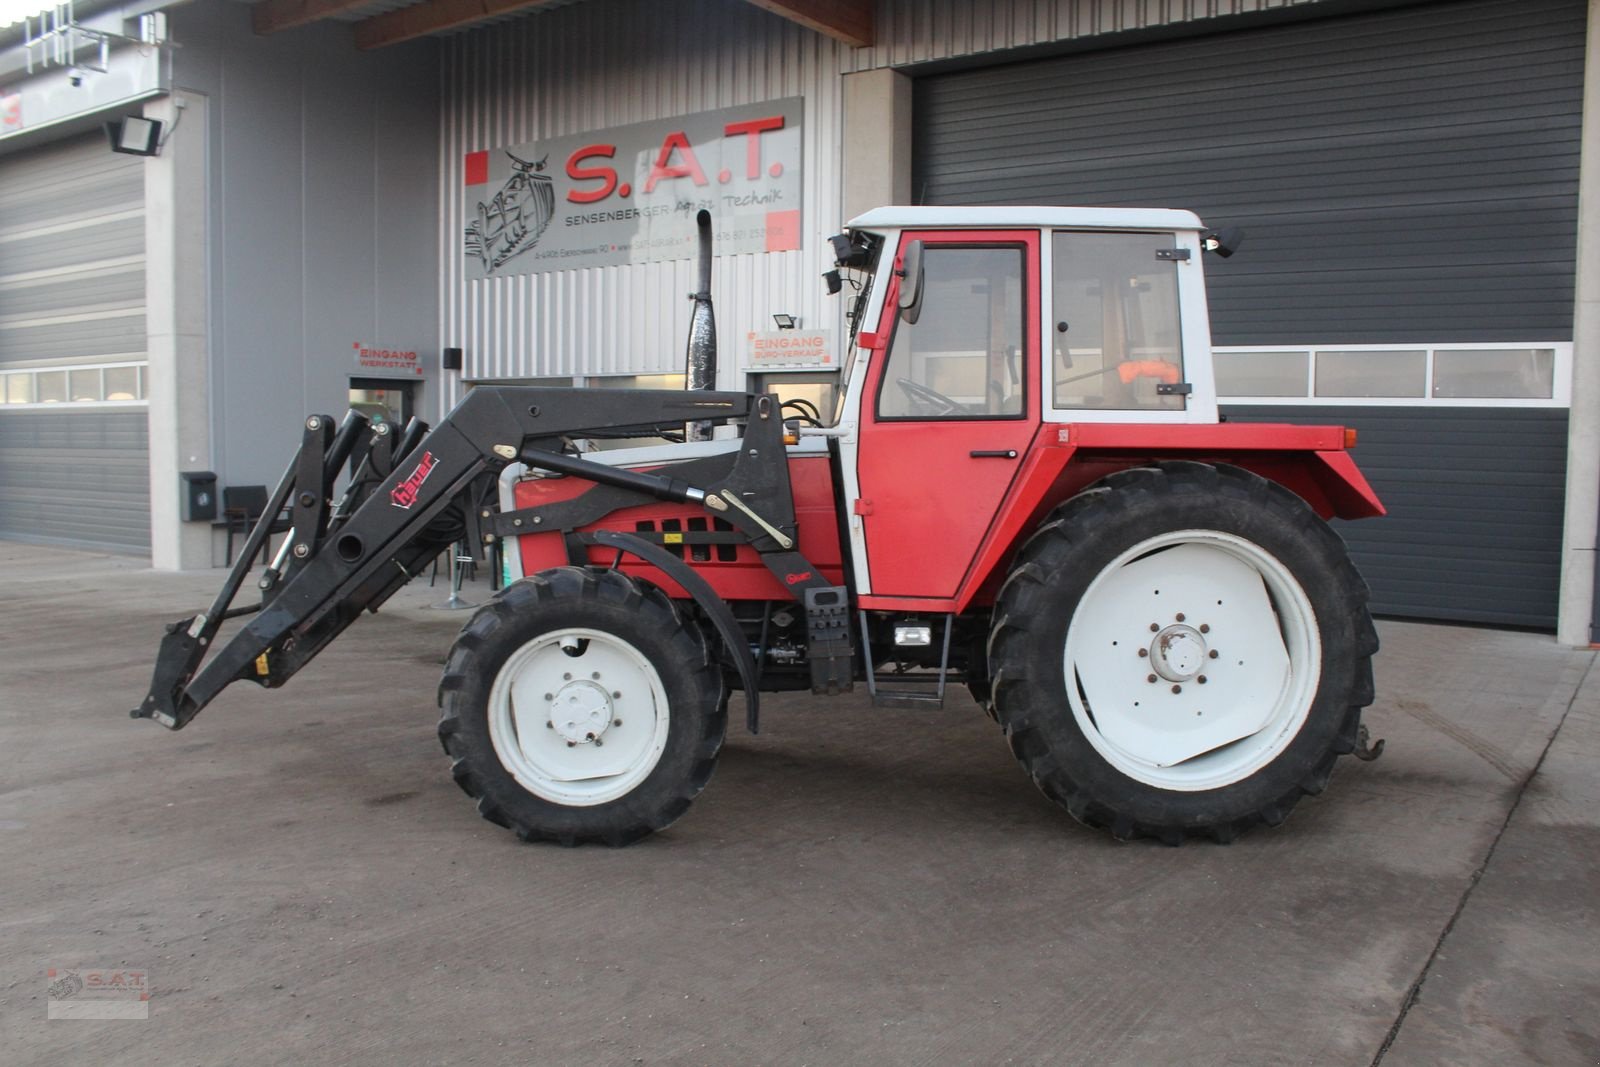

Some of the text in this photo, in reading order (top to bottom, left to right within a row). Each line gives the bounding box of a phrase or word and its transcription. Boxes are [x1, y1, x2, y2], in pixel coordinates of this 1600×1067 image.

[565, 116, 785, 205] S.A.T.
[565, 206, 669, 226] SENSENBERGER
[723, 189, 783, 207] Technik
[754, 337, 824, 349] EINGANG
[360, 349, 417, 360] EINGANG
[360, 360, 417, 369] WERKSTATT
